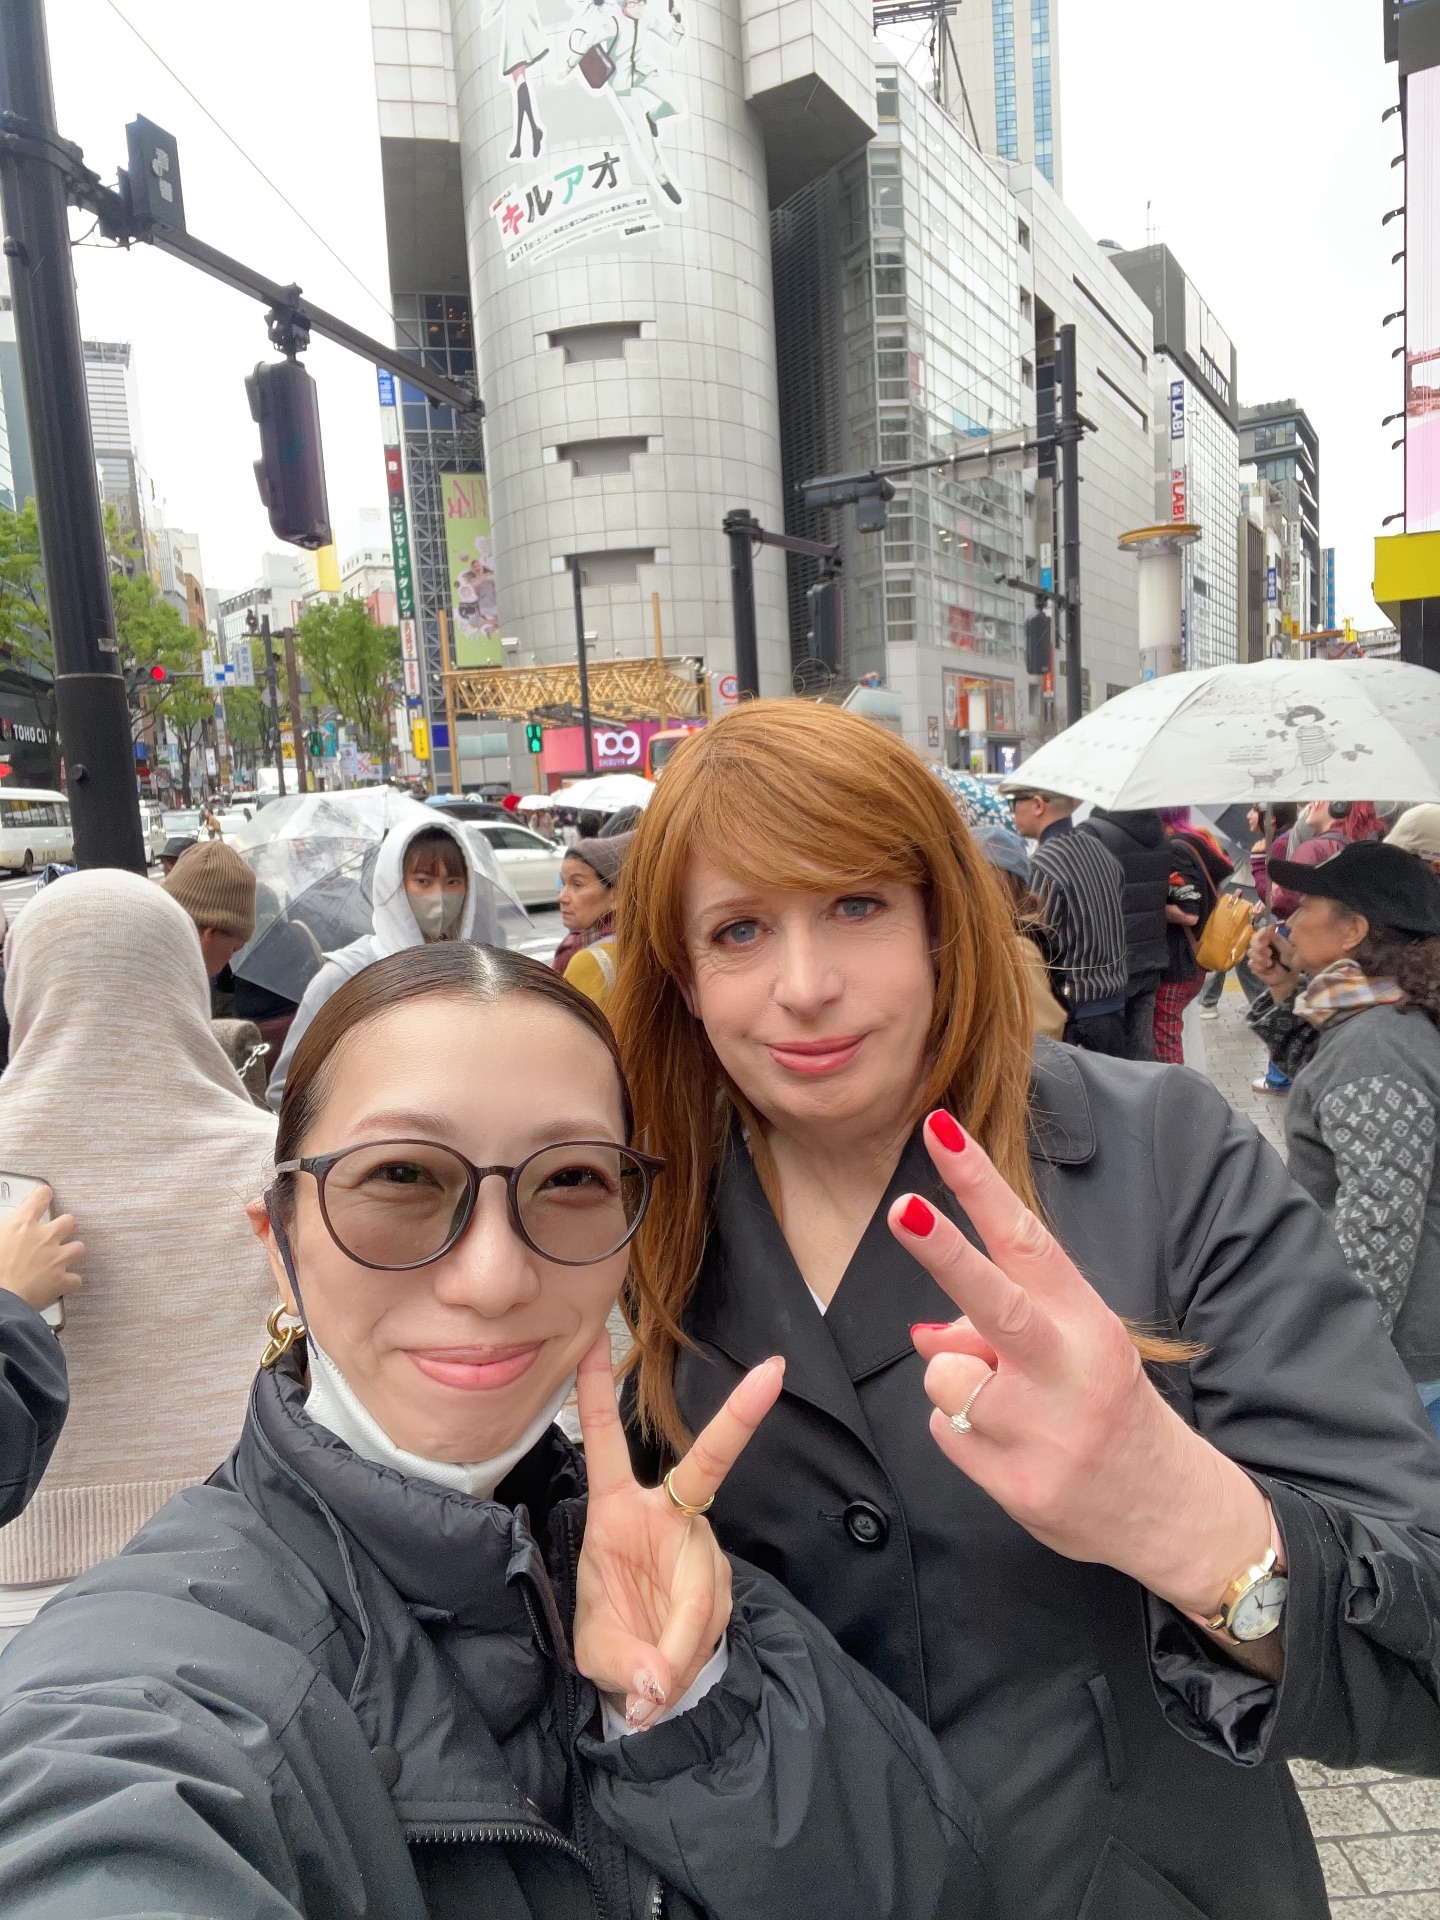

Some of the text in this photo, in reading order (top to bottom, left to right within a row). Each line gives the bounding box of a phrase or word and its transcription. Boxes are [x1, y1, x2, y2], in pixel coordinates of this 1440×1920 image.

[502, 152, 620, 235] キルアオ
[1172, 403, 1184, 438] LABI
[1172, 482, 1184, 523] LABI
[393, 511, 411, 610] ビリヤード・ダーツ
[13, 724, 35, 743] TOHO
[594, 731, 640, 765] 109
